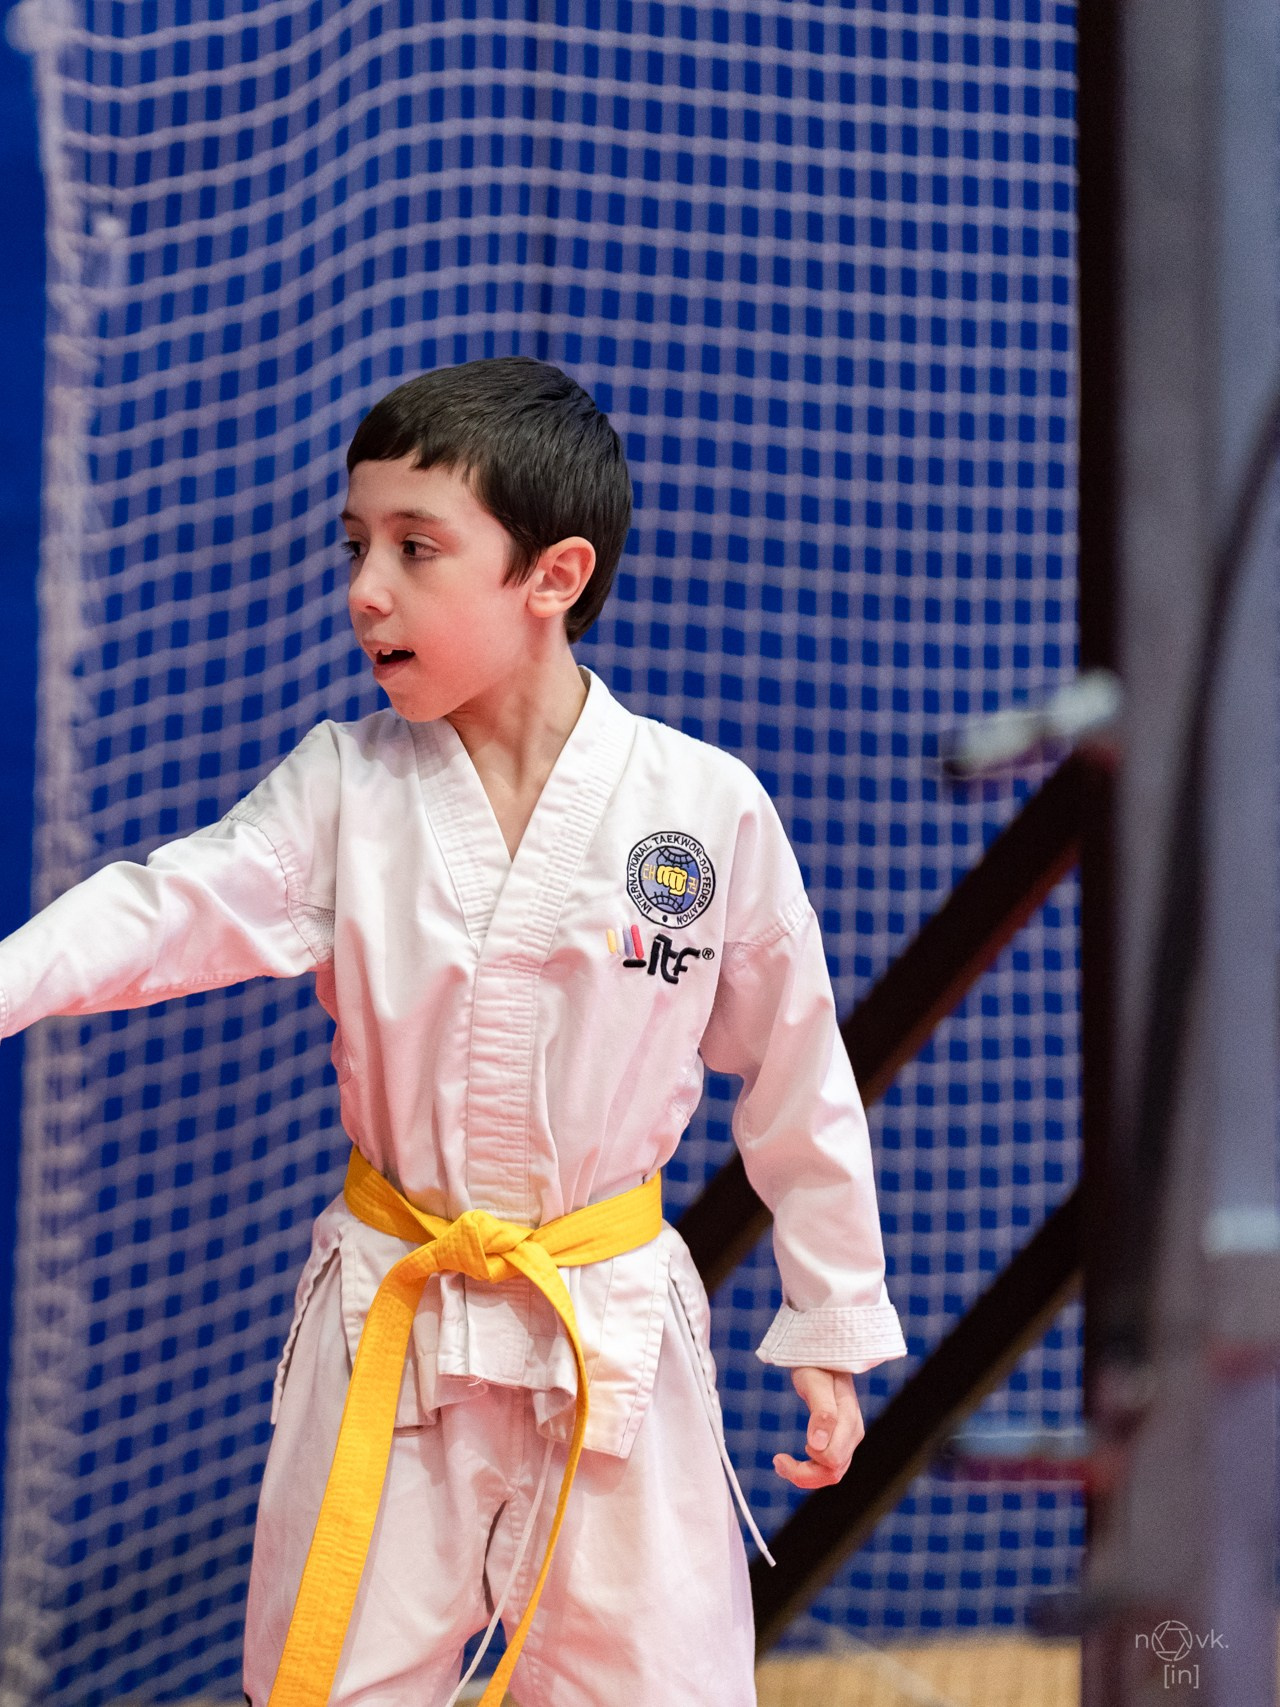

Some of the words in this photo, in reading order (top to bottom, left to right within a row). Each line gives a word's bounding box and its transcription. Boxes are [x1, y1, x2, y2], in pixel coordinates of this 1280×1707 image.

[628, 843, 653, 915] INTERNATIONAL
[651, 834, 710, 876] TAEKWON-DO
[676, 876, 712, 926] FEDERATION
